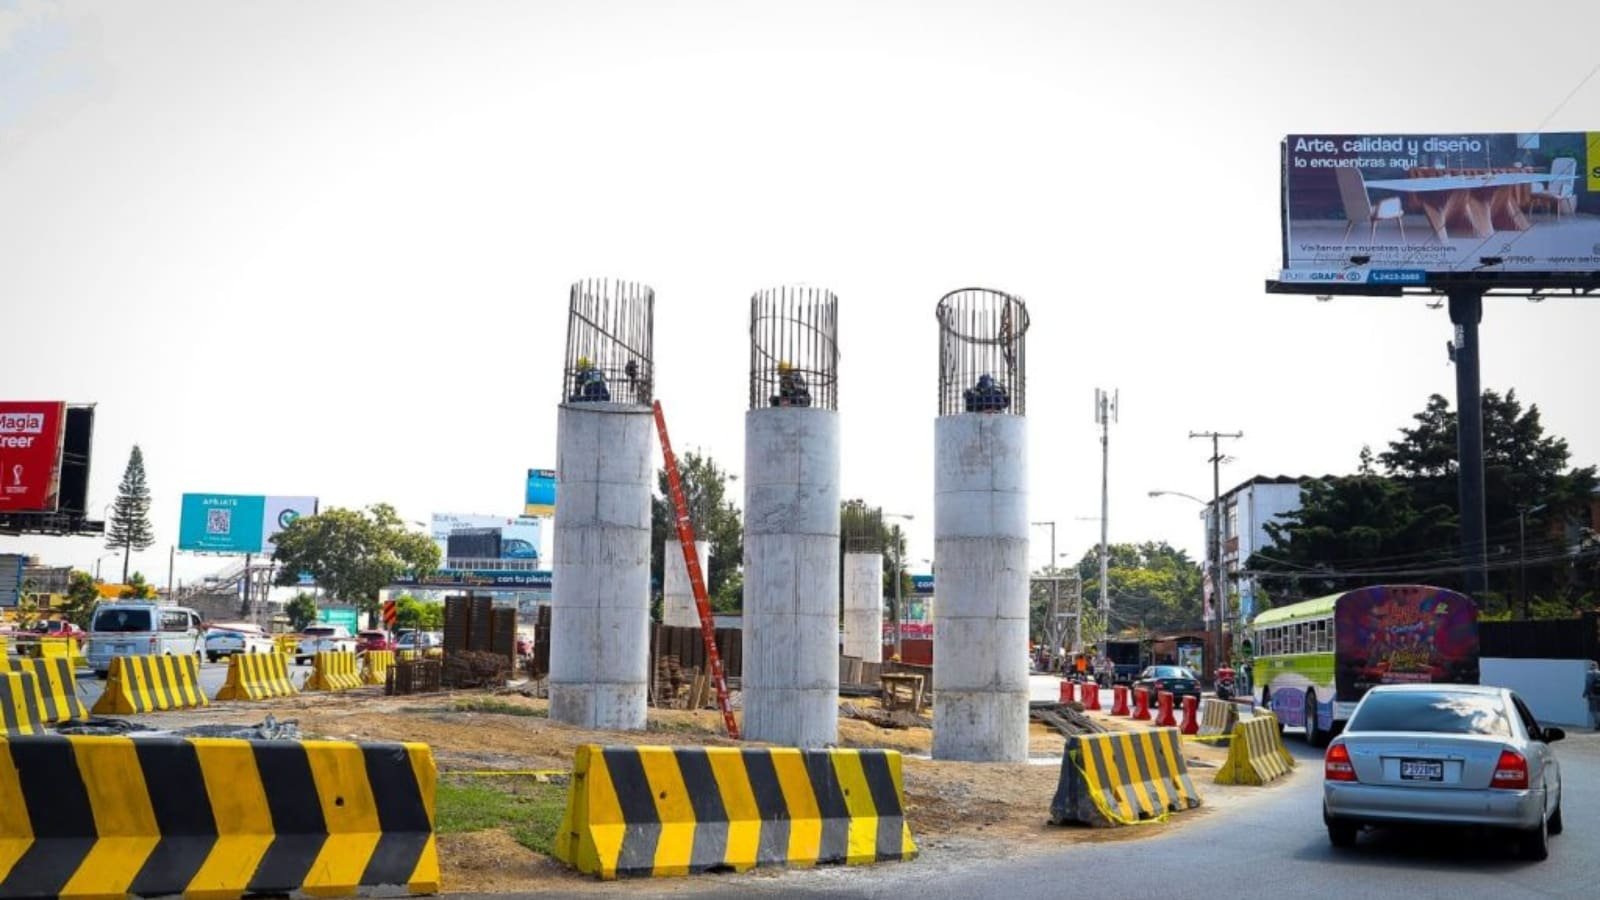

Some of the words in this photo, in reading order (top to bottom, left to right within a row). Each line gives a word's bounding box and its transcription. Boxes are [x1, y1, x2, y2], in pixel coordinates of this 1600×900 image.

[1294, 138, 1338, 154] Arte,
[1343, 137, 1403, 152] calidad
[1408, 141, 1418, 155] y
[1423, 137, 1481, 152] diseño
[1294, 157, 1307, 168] lo
[1310, 158, 1386, 168] encuentras
[1359, 244, 1399, 252] nuestras
[1401, 244, 1457, 254] ubicaciones
[0, 435, 34, 448] reer
[498, 574, 514, 584] con
